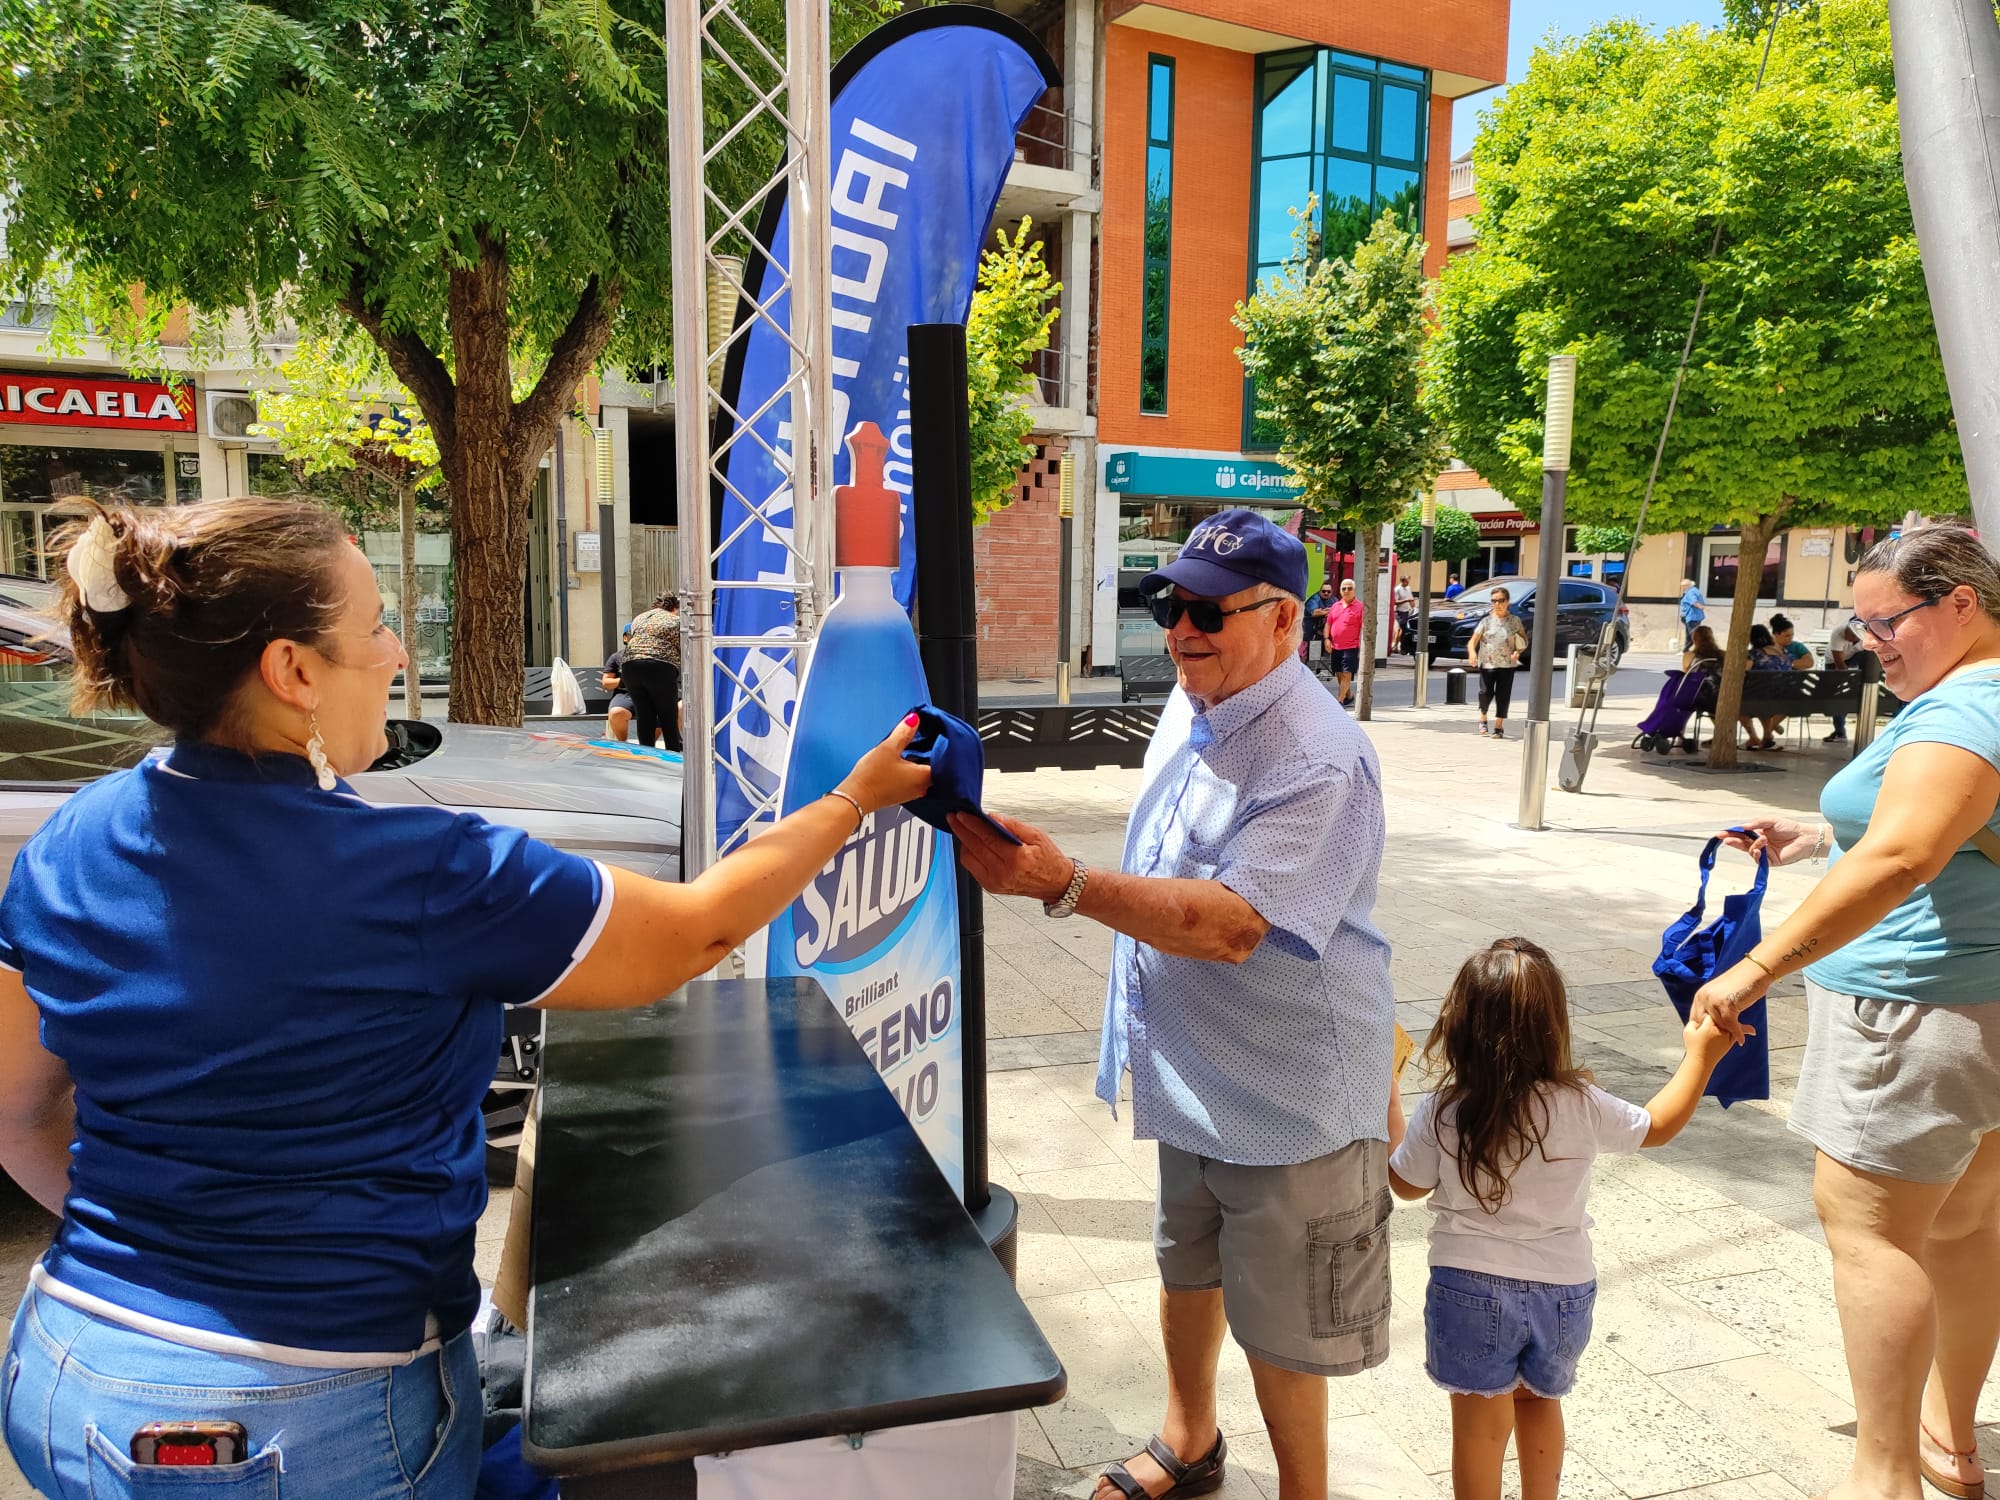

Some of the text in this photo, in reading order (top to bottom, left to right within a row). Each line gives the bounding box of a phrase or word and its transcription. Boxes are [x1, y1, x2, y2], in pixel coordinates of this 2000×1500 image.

[0, 385, 183, 420] ICAELA
[1478, 518, 1536, 531] ración Propia
[796, 815, 933, 967] SALUD
[845, 971, 900, 1019] Brilliant
